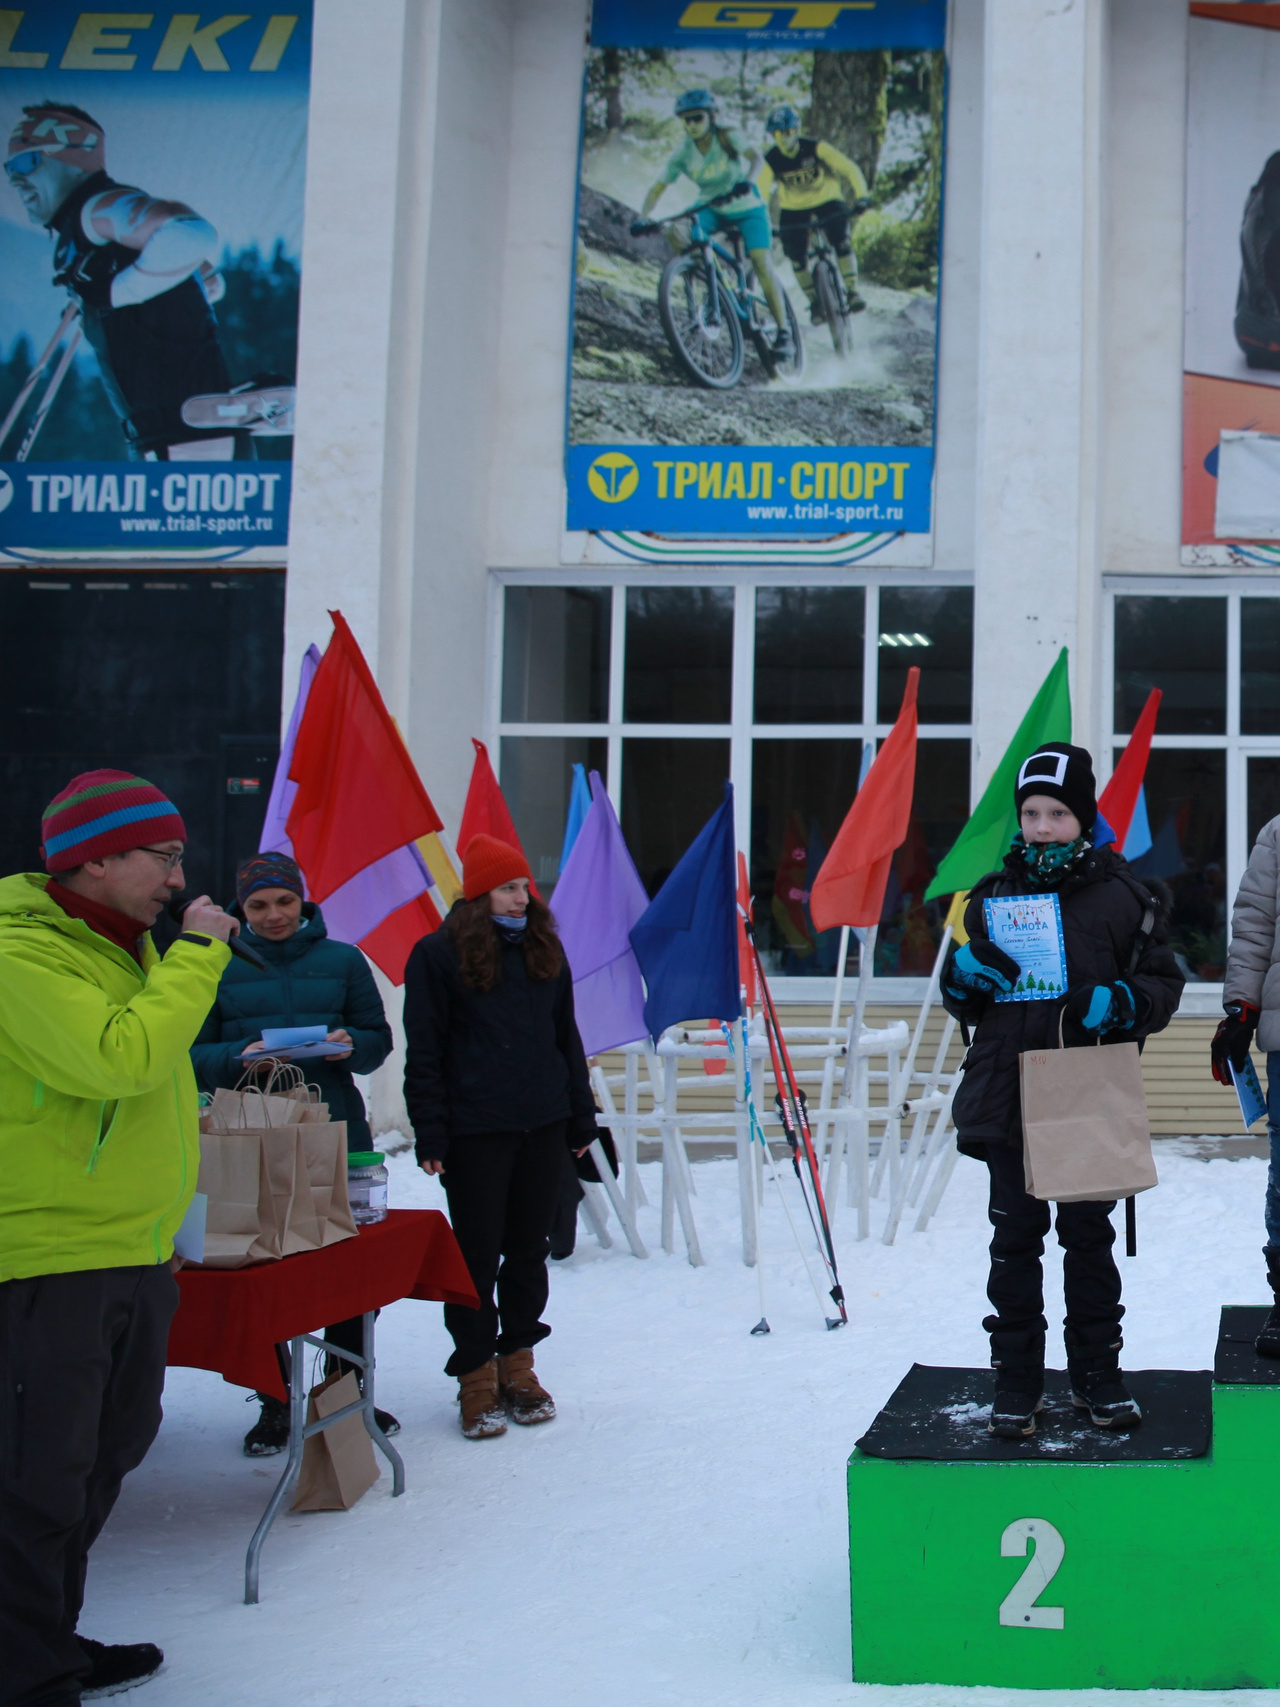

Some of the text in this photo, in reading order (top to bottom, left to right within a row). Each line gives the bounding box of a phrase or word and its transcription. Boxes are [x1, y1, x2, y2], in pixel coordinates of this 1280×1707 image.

[678, 1, 876, 29] GT
[0, 9, 299, 72] LEKI
[120, 515, 273, 535] www.trial-sport.ru
[747, 503, 903, 523] www.trial-sport.ru
[1001, 921, 1049, 933] ГРАМОТА
[782, 1097, 795, 1131] NORDWAY
[795, 1096, 808, 1129] NORDWAY
[1000, 1517, 1065, 1630] 2
